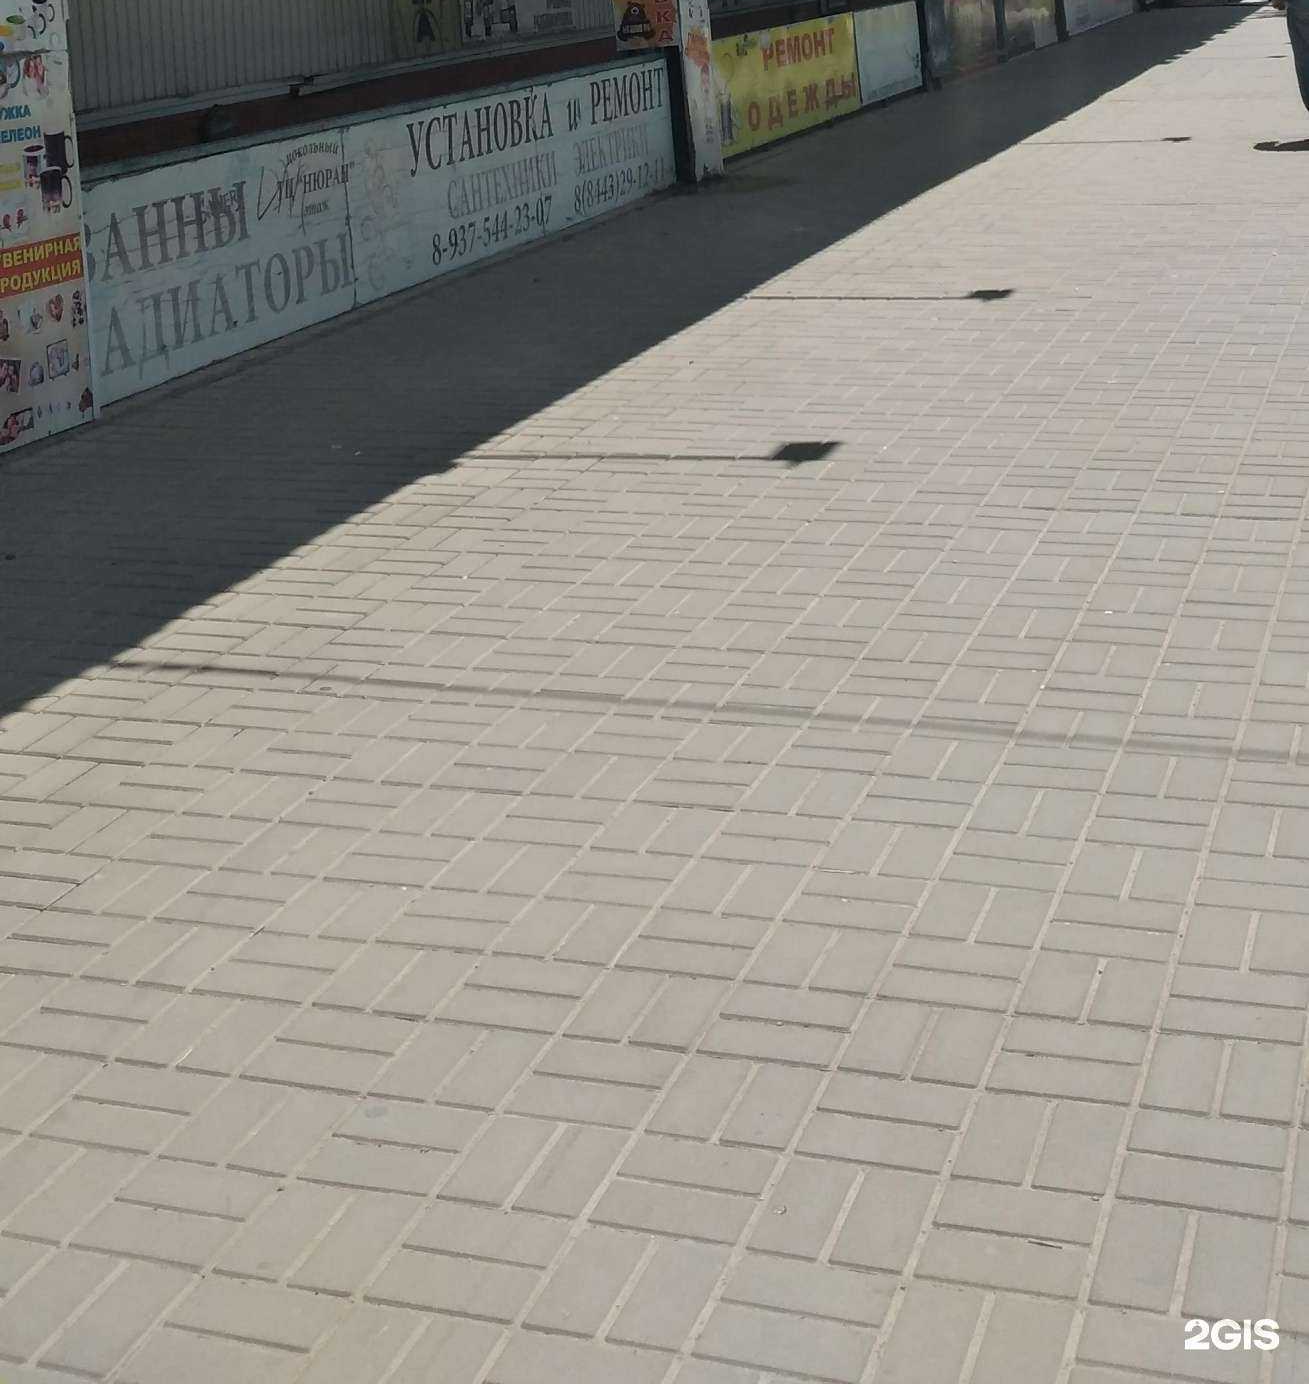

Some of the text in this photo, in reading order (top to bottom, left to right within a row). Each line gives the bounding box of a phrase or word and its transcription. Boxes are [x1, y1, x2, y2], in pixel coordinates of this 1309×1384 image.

[760, 27, 835, 71] РЕМОНТ
[406, 91, 554, 177] УСТАНОВКА
[590, 66, 665, 125] РЕМОНТ
[747, 72, 858, 132] ОДЕЖДЫ
[448, 149, 559, 219] САНТЕХНИКИ
[0, 237, 81, 269] ВЕНИРНАЯ
